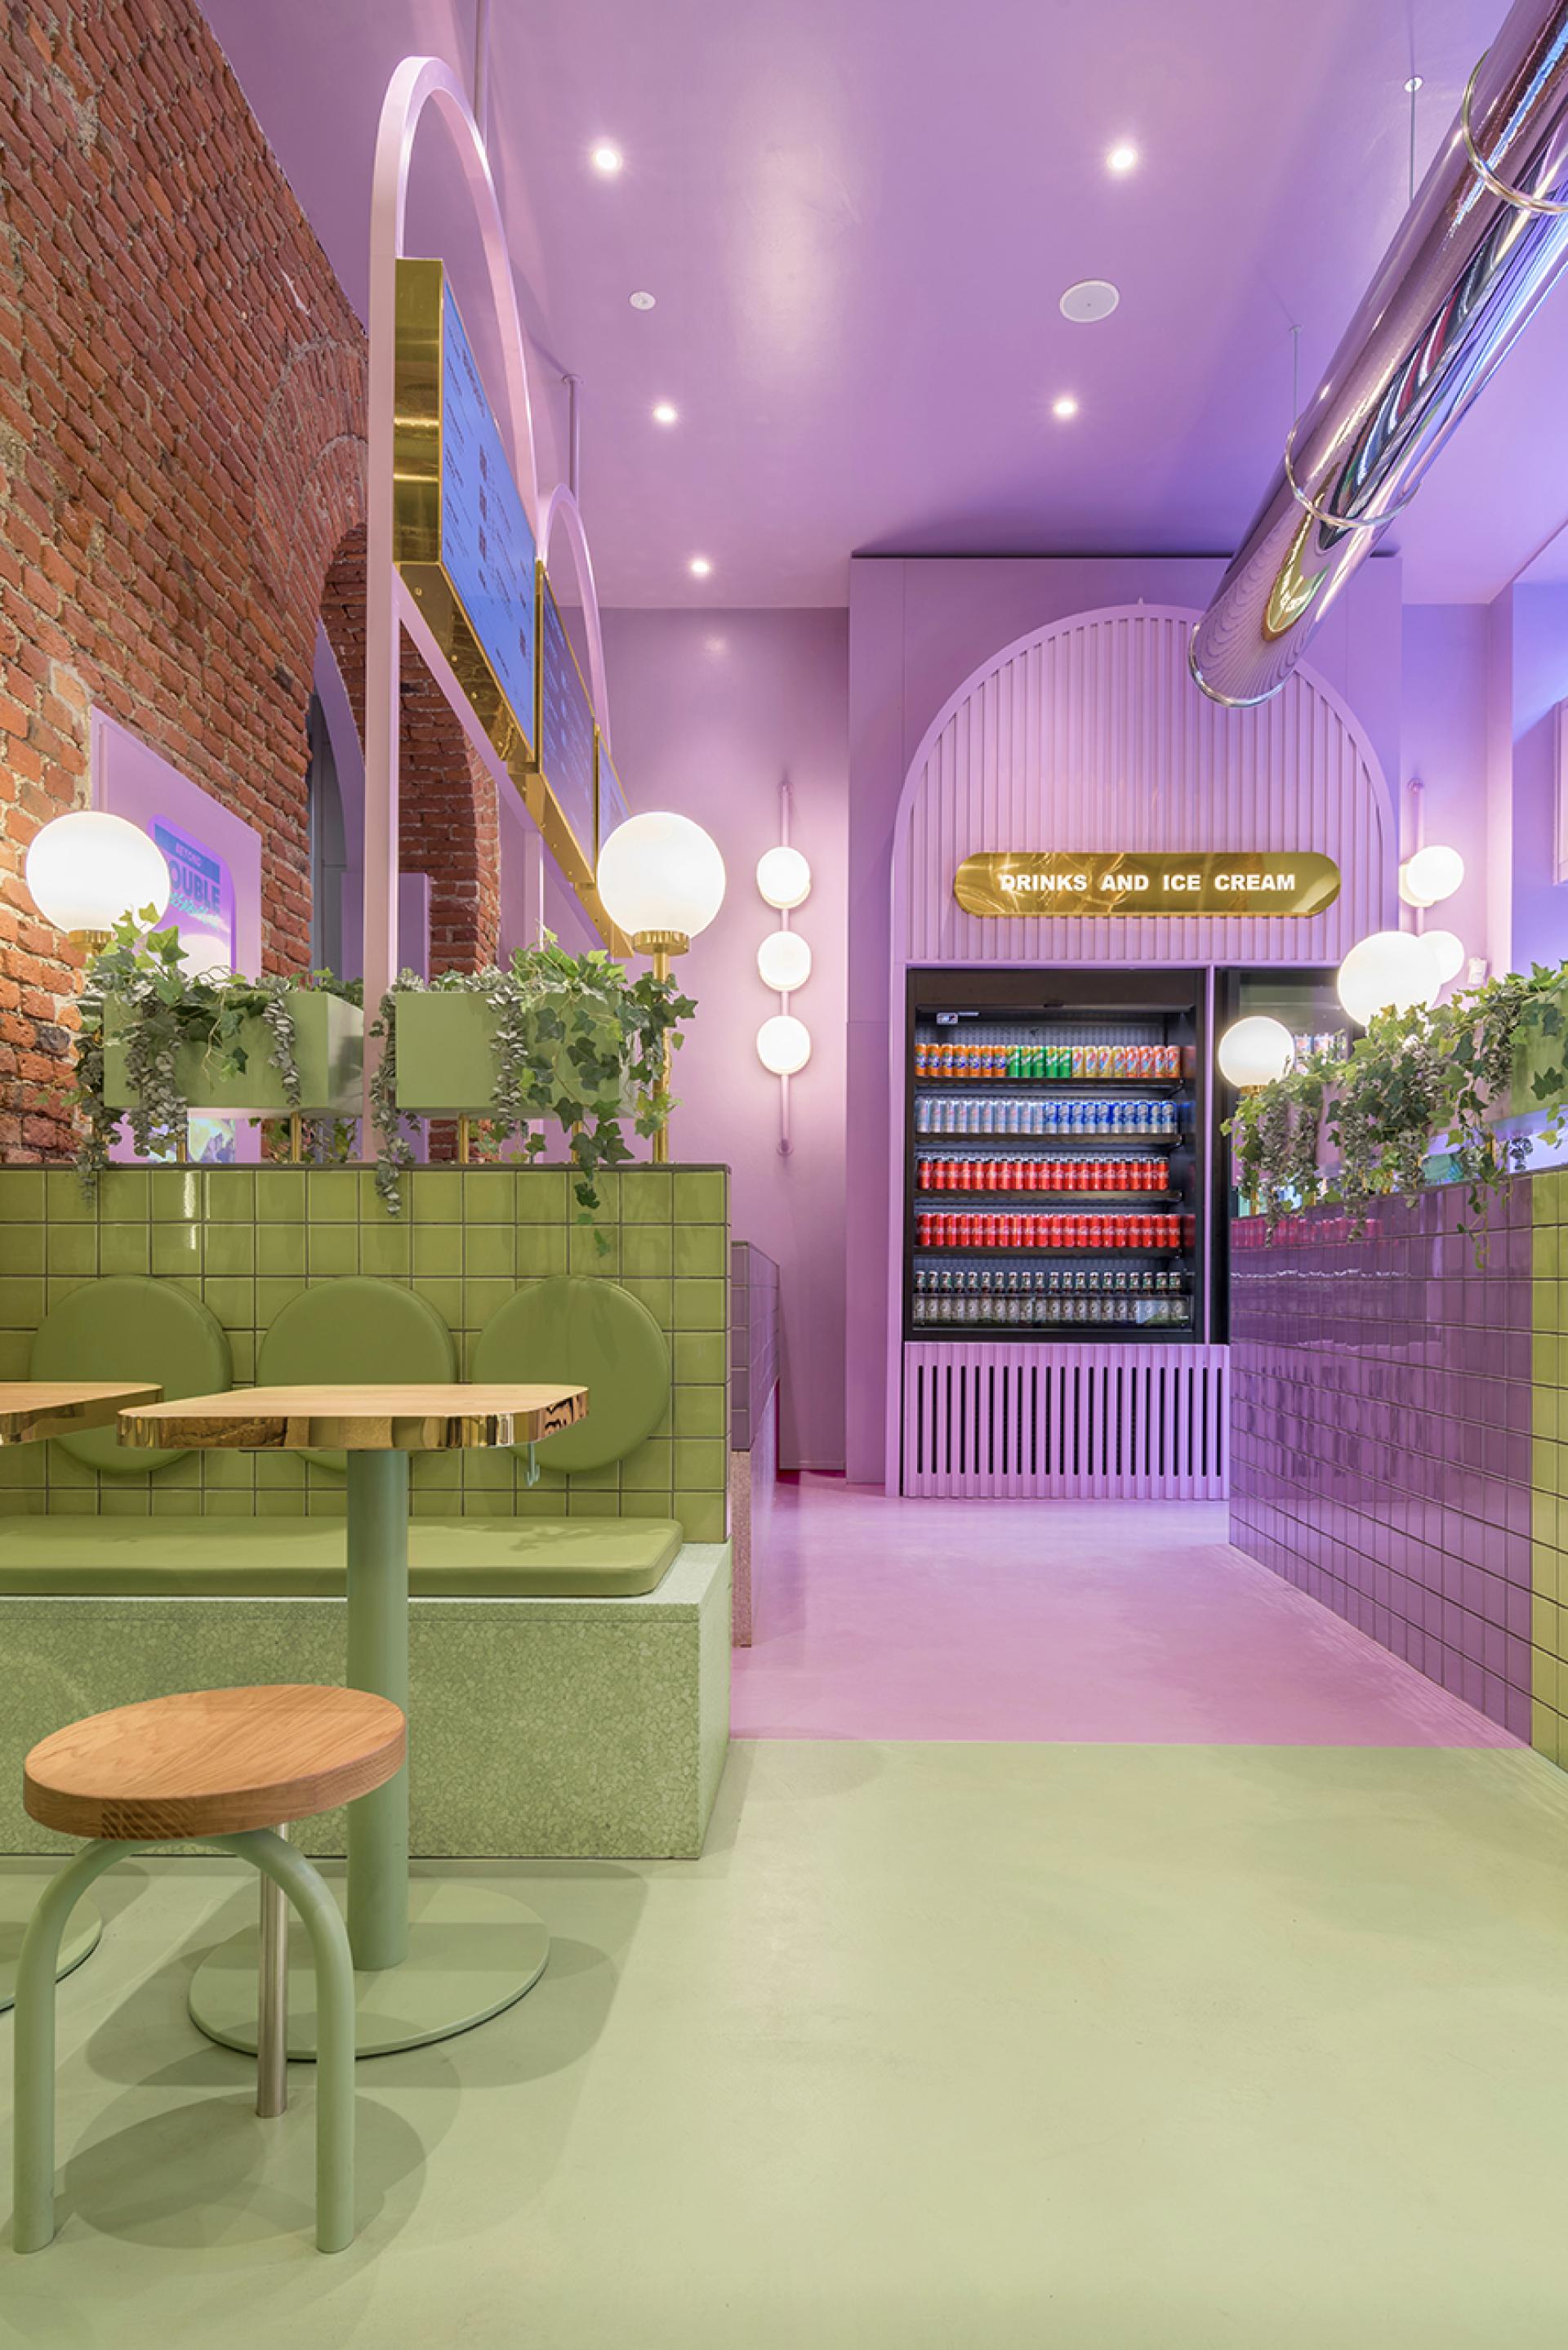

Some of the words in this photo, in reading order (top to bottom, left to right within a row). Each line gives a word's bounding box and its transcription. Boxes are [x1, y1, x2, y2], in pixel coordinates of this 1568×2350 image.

[169, 860, 220, 914] OUBLE
[1000, 874, 1088, 891] DRINKS
[1100, 874, 1149, 891] AND
[1163, 874, 1201, 891] ICE
[1214, 874, 1295, 891] CREAM
